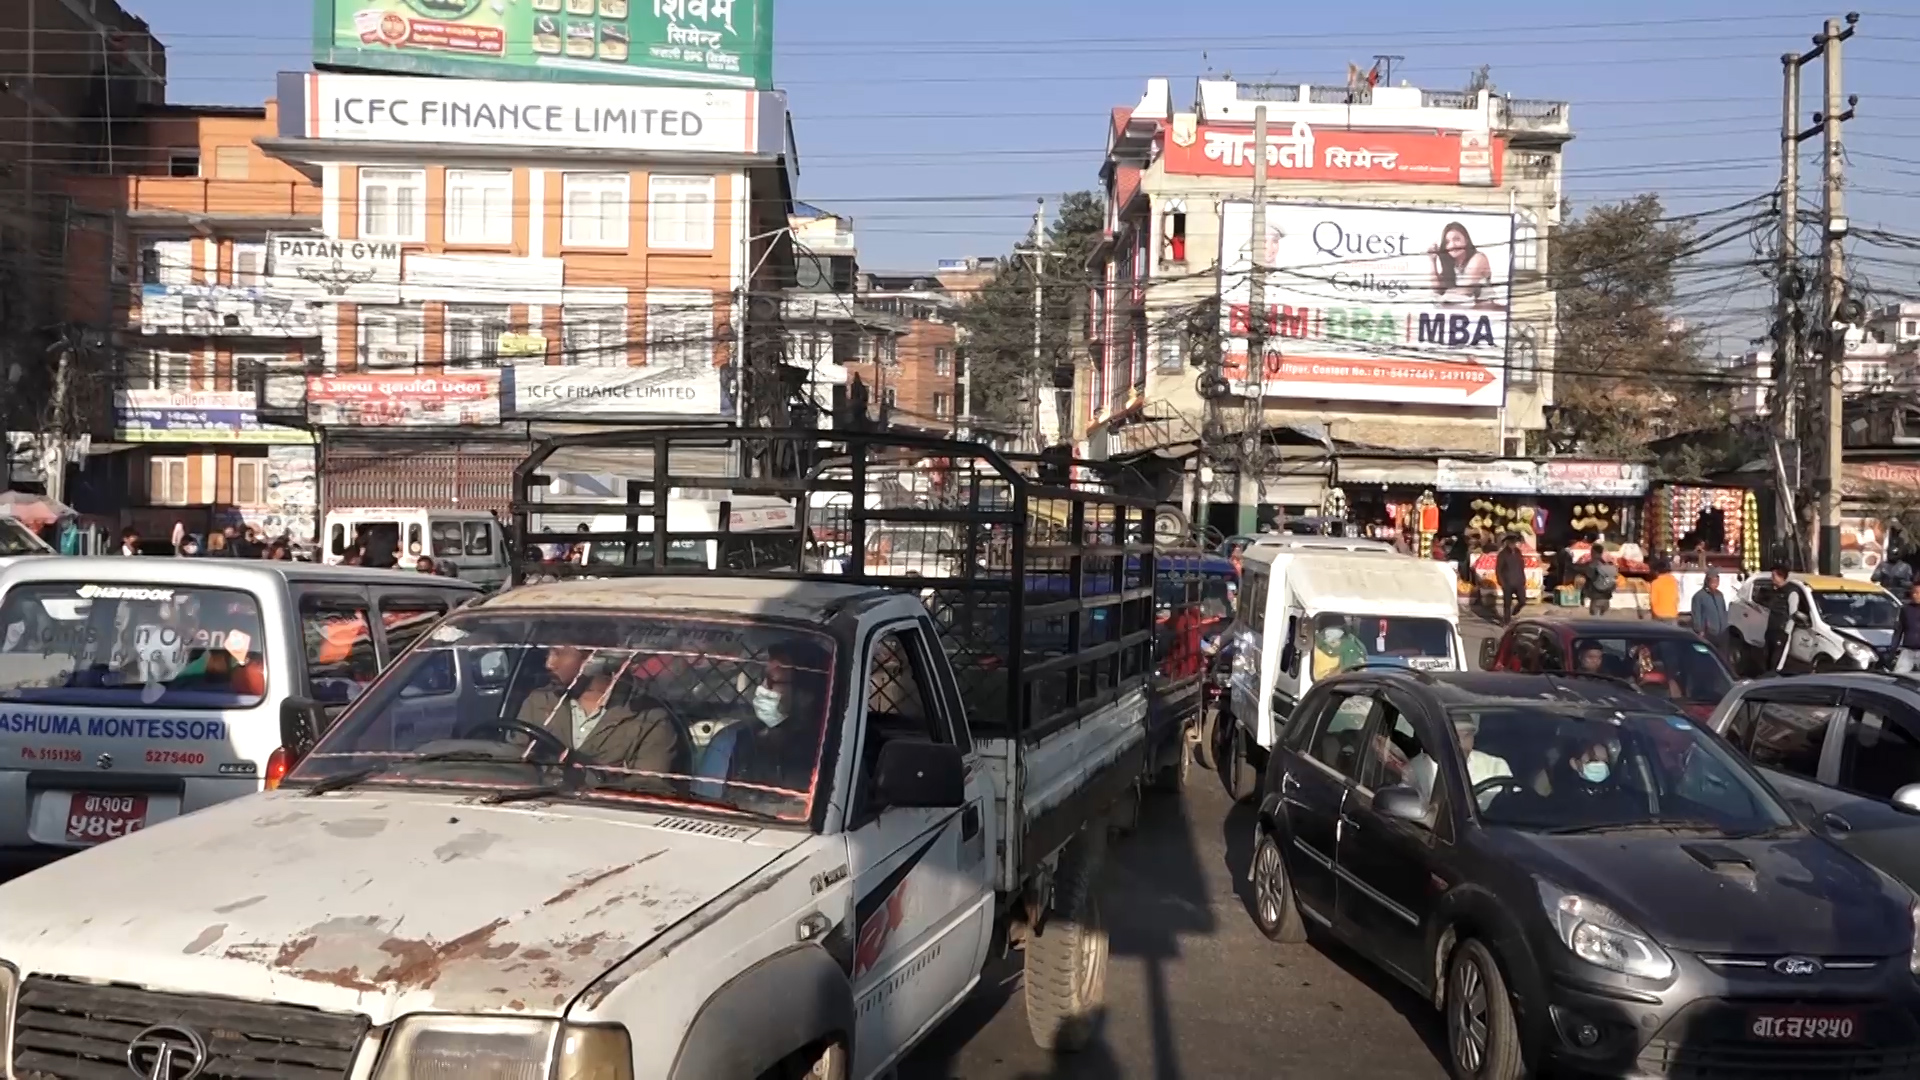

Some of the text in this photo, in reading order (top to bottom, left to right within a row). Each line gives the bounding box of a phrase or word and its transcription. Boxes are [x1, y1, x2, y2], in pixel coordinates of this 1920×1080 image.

[666, 22, 722, 49] सिमेन्ट
[335, 97, 704, 137] ICFC FINANCE LIMITED
[1323, 146, 1400, 170] सिमेन्ट
[280, 240, 397, 260] PATAN GYM
[1312, 220, 1410, 258] Quest
[1331, 271, 1410, 298] College
[1326, 306, 1397, 343] BBA
[1418, 312, 1496, 347] MBA
[1312, 364, 1350, 377] Contact
[527, 385, 696, 400] ICFC FINANCE LIMITED
[88, 716, 226, 741] MONTESSORI
[1785, 960, 1815, 975] Ford
